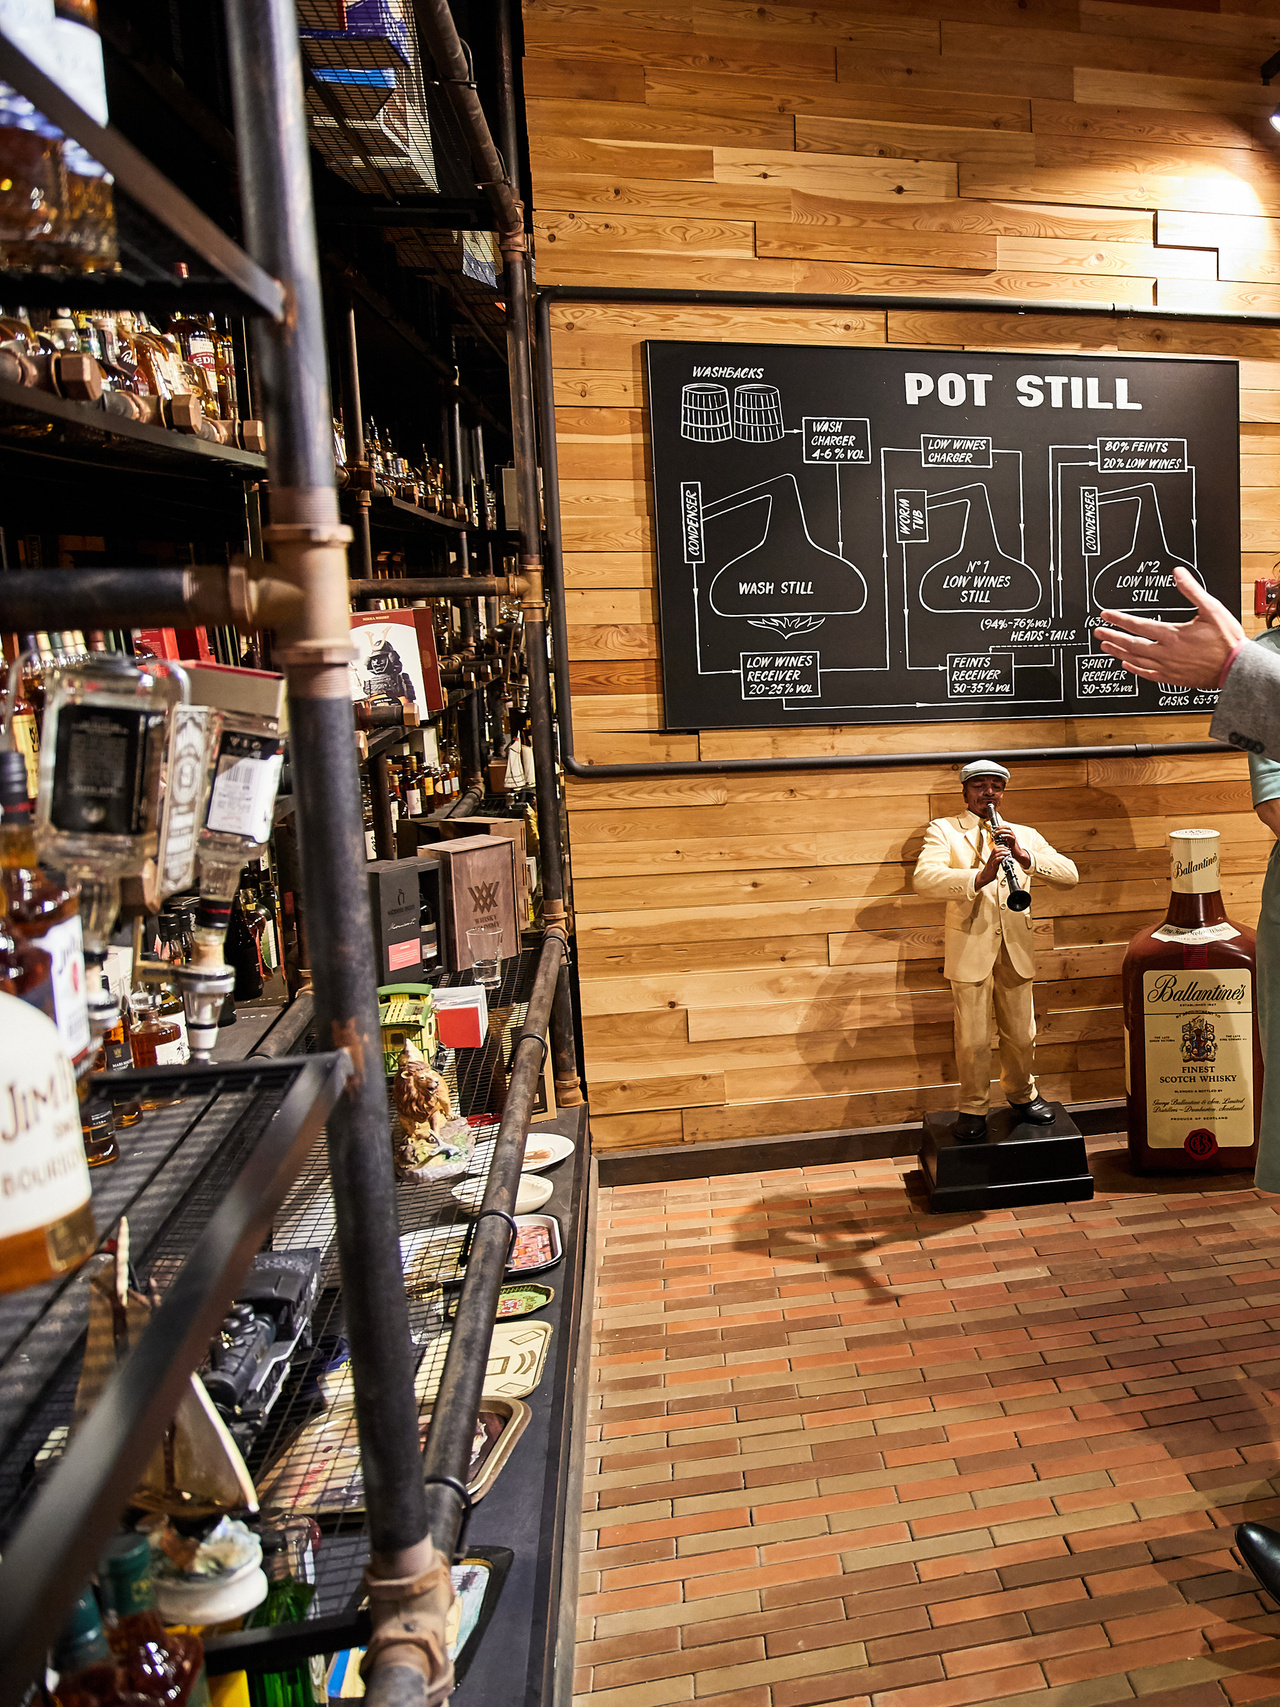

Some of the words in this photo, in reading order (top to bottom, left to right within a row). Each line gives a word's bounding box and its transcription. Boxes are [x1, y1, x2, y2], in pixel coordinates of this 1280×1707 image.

[692, 366, 765, 379] WASHBACKS
[904, 372, 993, 407] POT
[1016, 374, 1143, 411] STILL
[811, 421, 842, 433] WASH
[811, 435, 856, 447] CHARGER
[928, 439, 951, 450] LOW
[953, 440, 987, 451] WINES
[1104, 441, 1129, 452] 80%
[1131, 442, 1168, 453] FEINTS
[846, 449, 865, 460] VOL
[928, 452, 973, 464] CHARGER
[1103, 458, 1124, 469] 20%
[1126, 459, 1148, 469] LOW
[1149, 458, 1181, 470] WINES
[898, 498, 910, 535] WORM
[912, 509, 923, 531] TUB
[1085, 490, 1095, 551] CONDENSER
[685, 490, 699, 556] CONDENSER
[942, 575, 971, 589] LOW
[973, 575, 1011, 588] WINES
[1116, 575, 1142, 588] LOW
[738, 581, 775, 595] WASH
[780, 581, 814, 595] STILL
[960, 590, 991, 603] STILL
[1131, 589, 1160, 602] STILL
[747, 656, 773, 668] LOW
[774, 655, 813, 667] WINES
[953, 657, 991, 668] FEINTS
[1081, 658, 1115, 669] SPIRIT
[747, 669, 801, 682] RECEIVER
[952, 670, 1001, 681] RECEIVER
[1081, 670, 1127, 682] RECEIVER
[796, 683, 813, 693] VOL
[995, 683, 1011, 693] VOL
[1158, 695, 1190, 706] CASKS
[1147, 974, 1246, 1003] Ballantine's
[1182, 1066, 1216, 1074] FINEST
[1200, 1075, 1237, 1083] WHISKY
